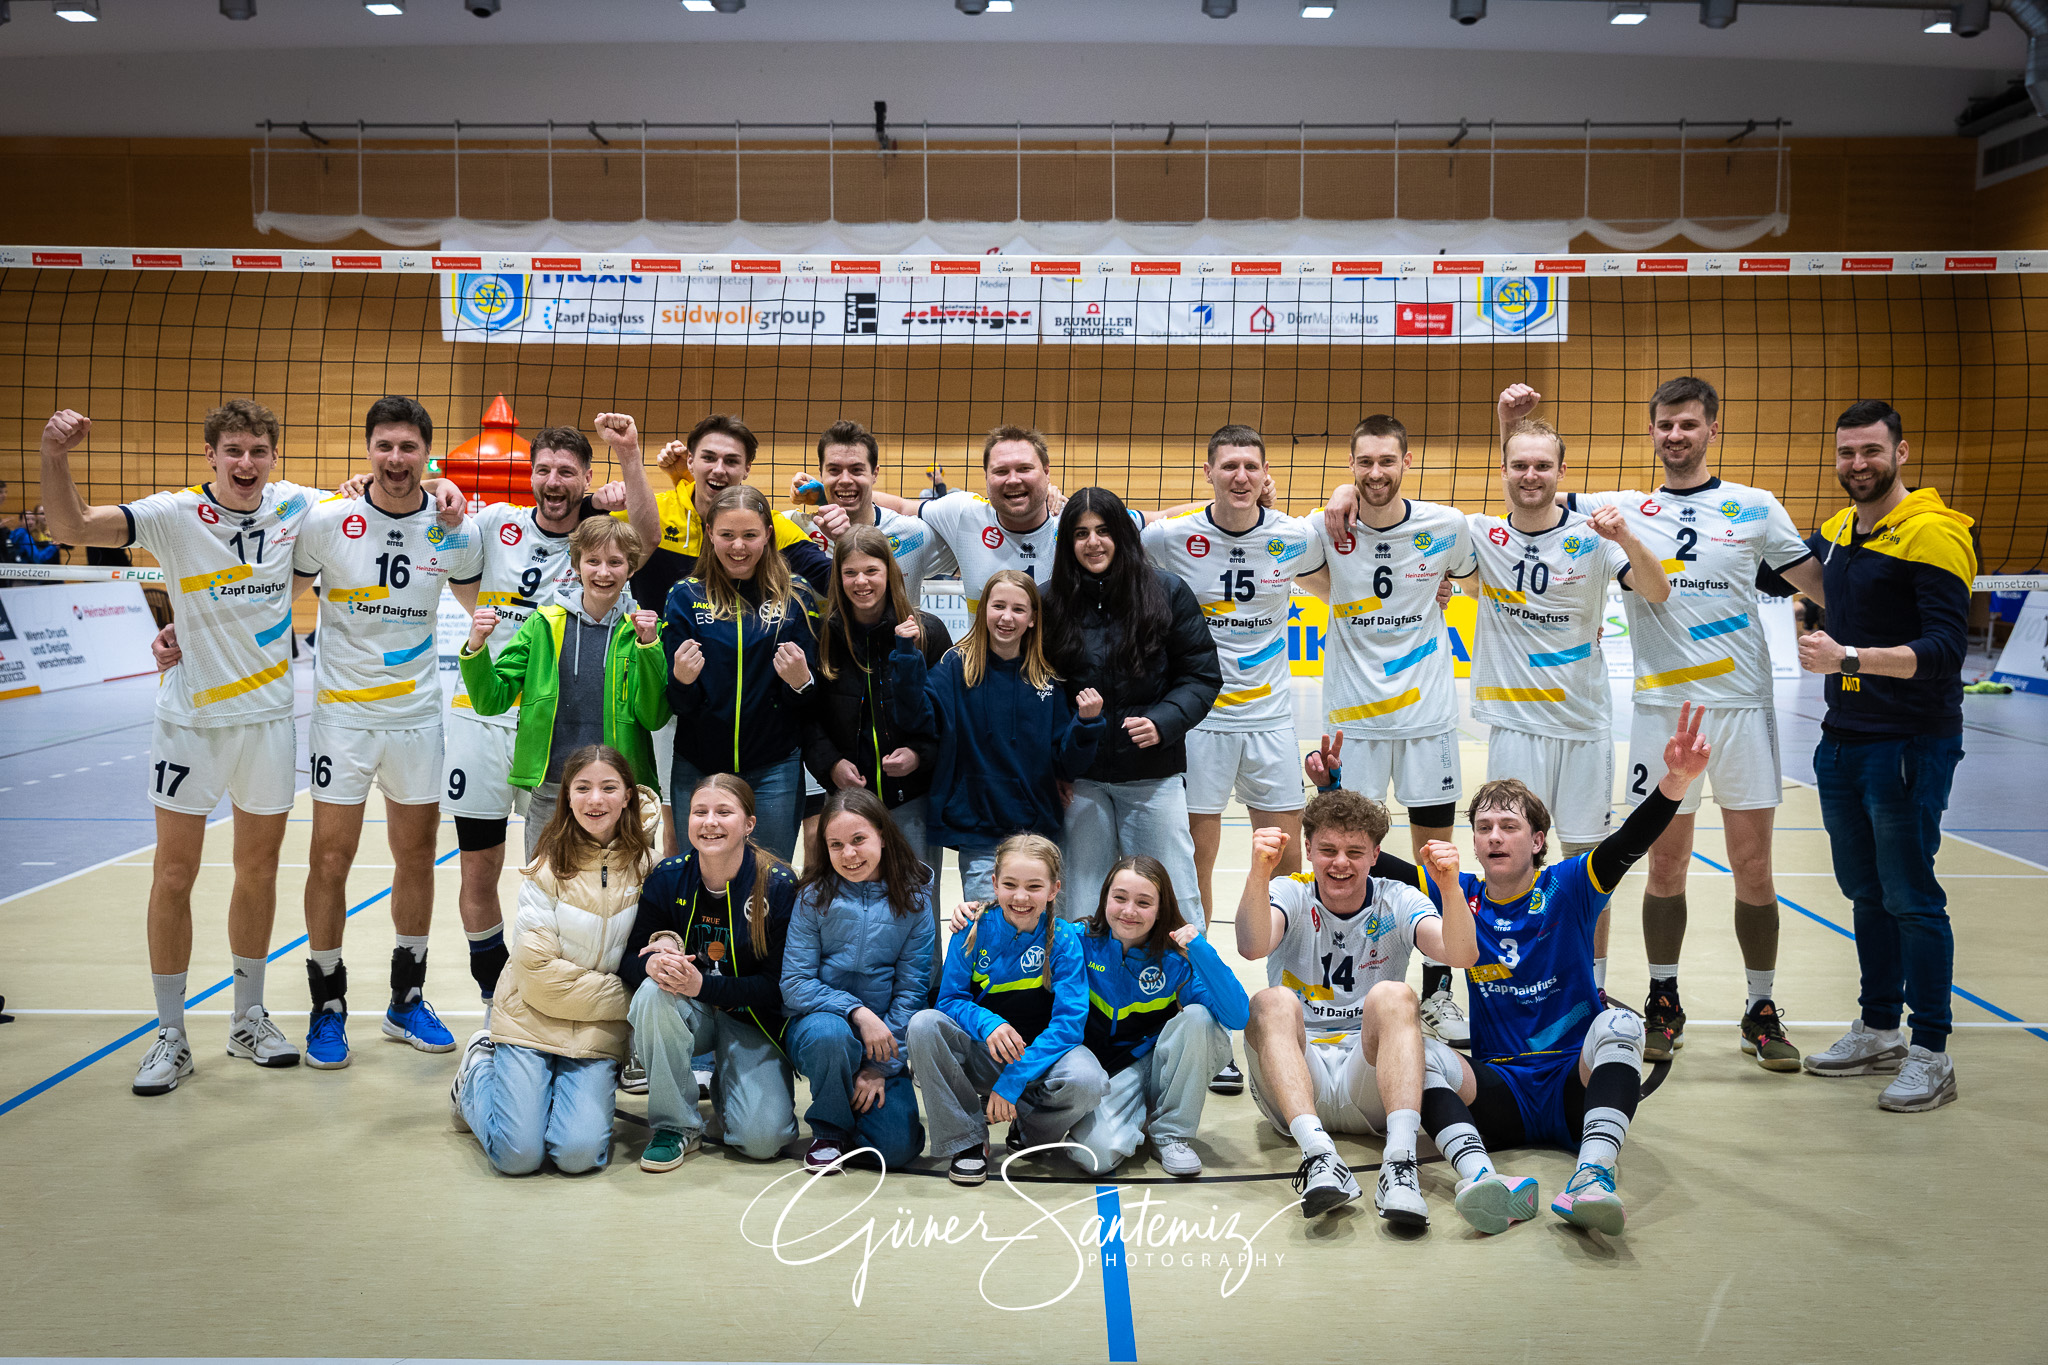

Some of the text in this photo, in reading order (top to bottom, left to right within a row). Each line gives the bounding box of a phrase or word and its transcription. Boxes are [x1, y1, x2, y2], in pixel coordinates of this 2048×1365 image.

[556, 312, 644, 327] Zapf Daigfuss
[901, 306, 1032, 329] schweiger
[1063, 328, 1124, 337] SERVICES
[229, 529, 265, 565] 17
[1675, 527, 1698, 562] 2
[0, 568, 51, 578] umsetzen
[375, 552, 411, 590] 16
[1511, 560, 1549, 596] 10
[220, 584, 246, 597] Zapf
[517, 567, 542, 599] 9
[1219, 570, 1256, 604] 15
[1372, 565, 1394, 601] 6
[1680, 578, 1729, 591] Daigfuss
[1986, 577, 2040, 591] umsetzen
[356, 601, 428, 618] Zapf Daigfuss
[695, 612, 715, 625] ES
[1351, 613, 1423, 628] Zapf Daigfuss
[1521, 609, 1570, 624] Daigfuss
[1206, 615, 1273, 629] Zapf Daigfuss
[154, 760, 191, 798] 17
[310, 752, 333, 788] 16
[1631, 762, 1649, 796] 2
[447, 767, 466, 801] 9
[701, 915, 721, 925] TRUE
[1497, 937, 1521, 970] 3
[1087, 961, 1106, 973] JAKO
[1320, 952, 1356, 993] 14
